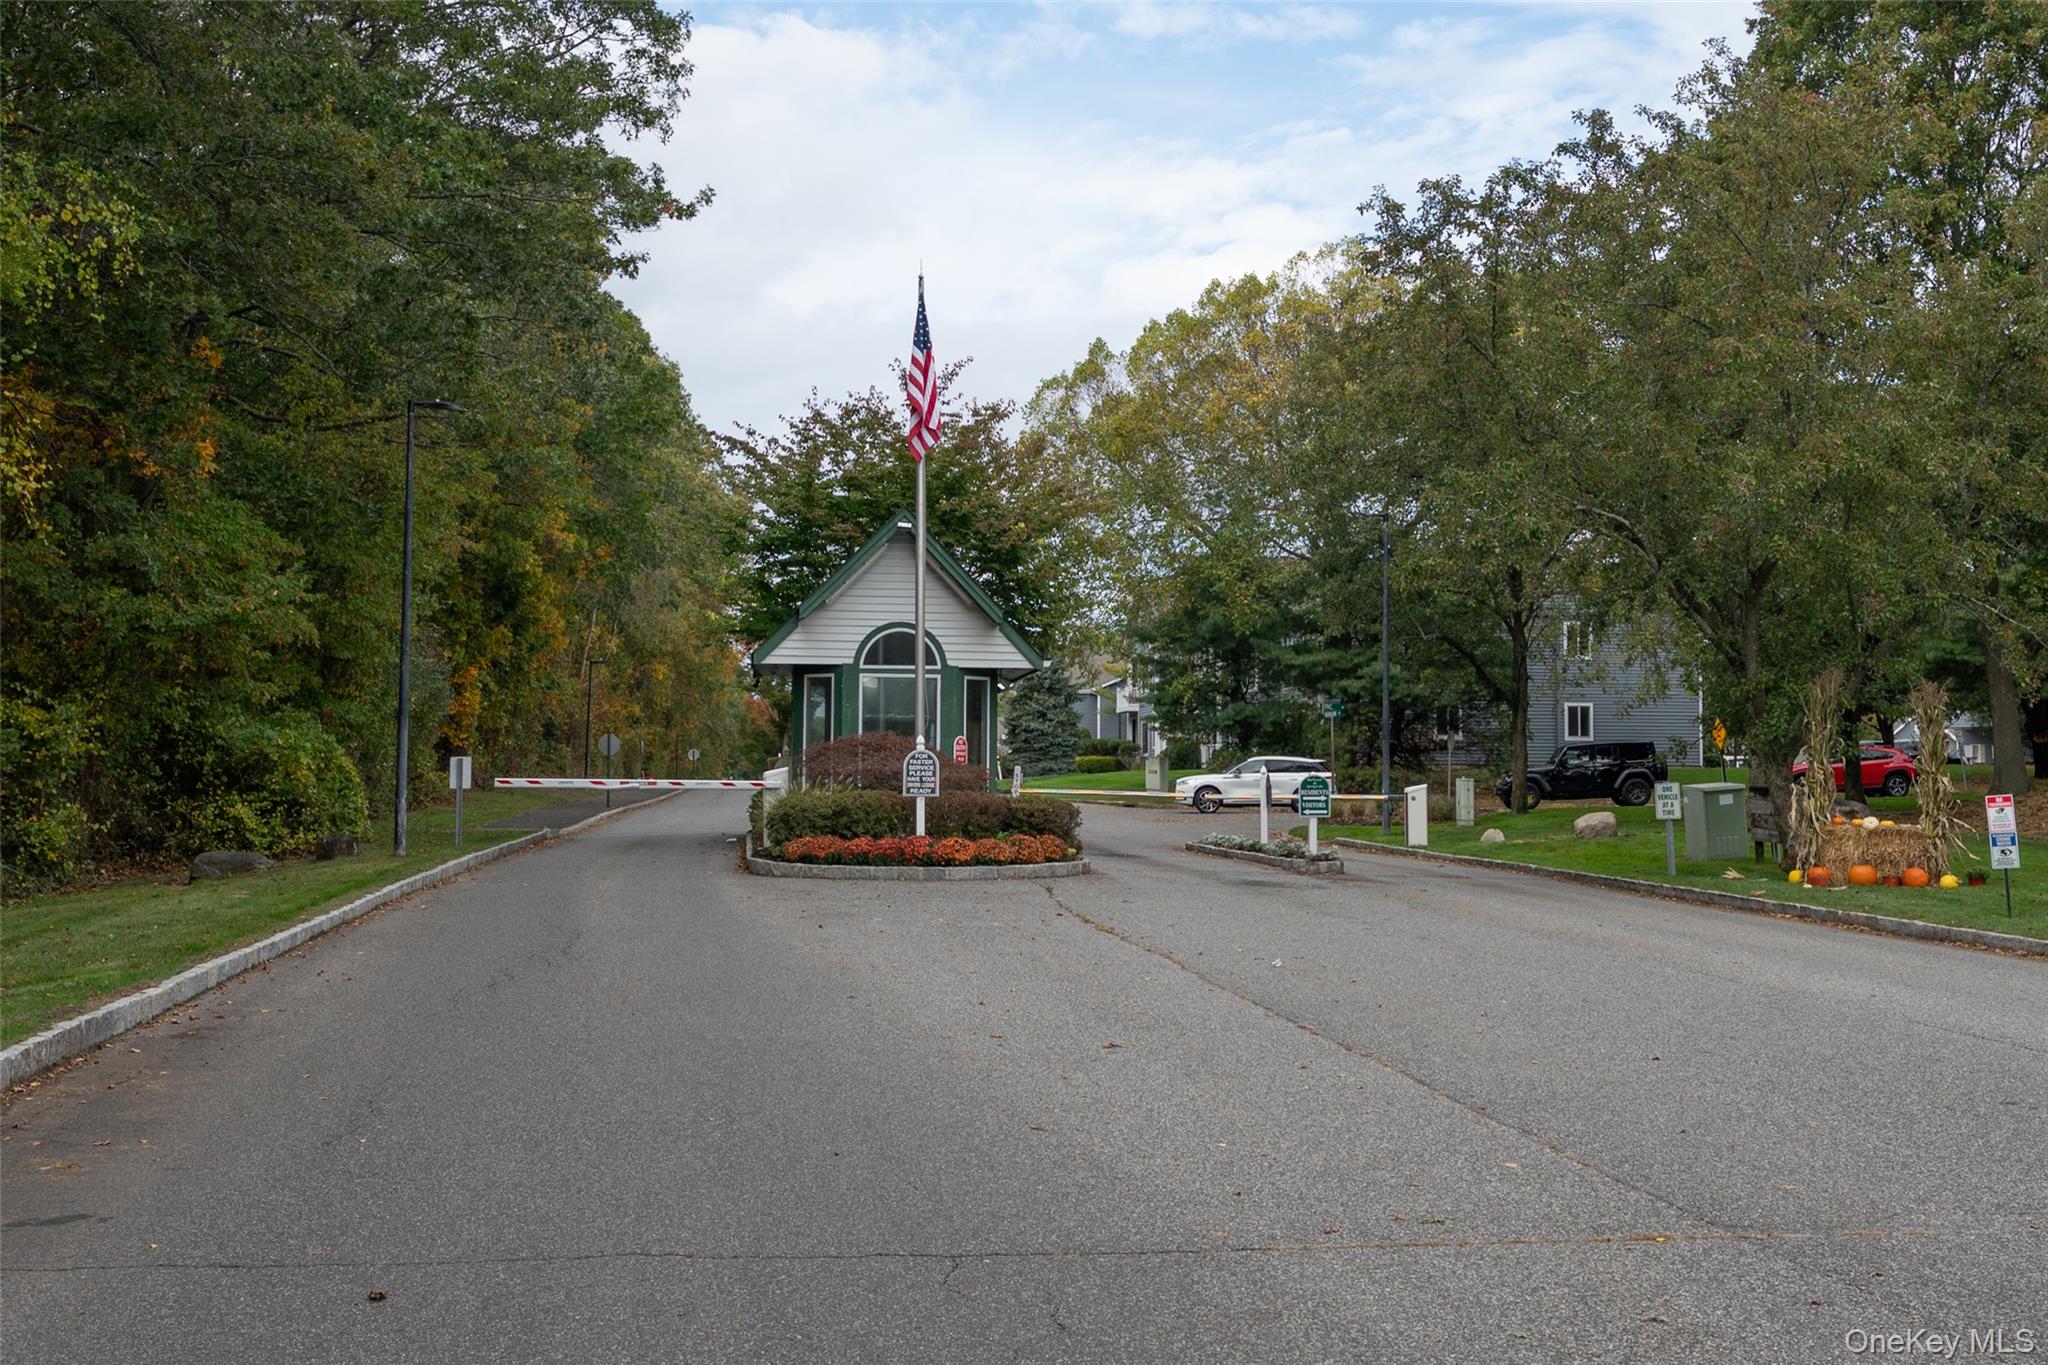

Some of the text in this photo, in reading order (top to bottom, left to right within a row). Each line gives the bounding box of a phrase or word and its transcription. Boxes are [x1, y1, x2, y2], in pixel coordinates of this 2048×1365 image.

[1661, 785, 1673, 793] ONE
[1658, 793, 1678, 801] VEHICLE
[1662, 801, 1669, 809] AT
